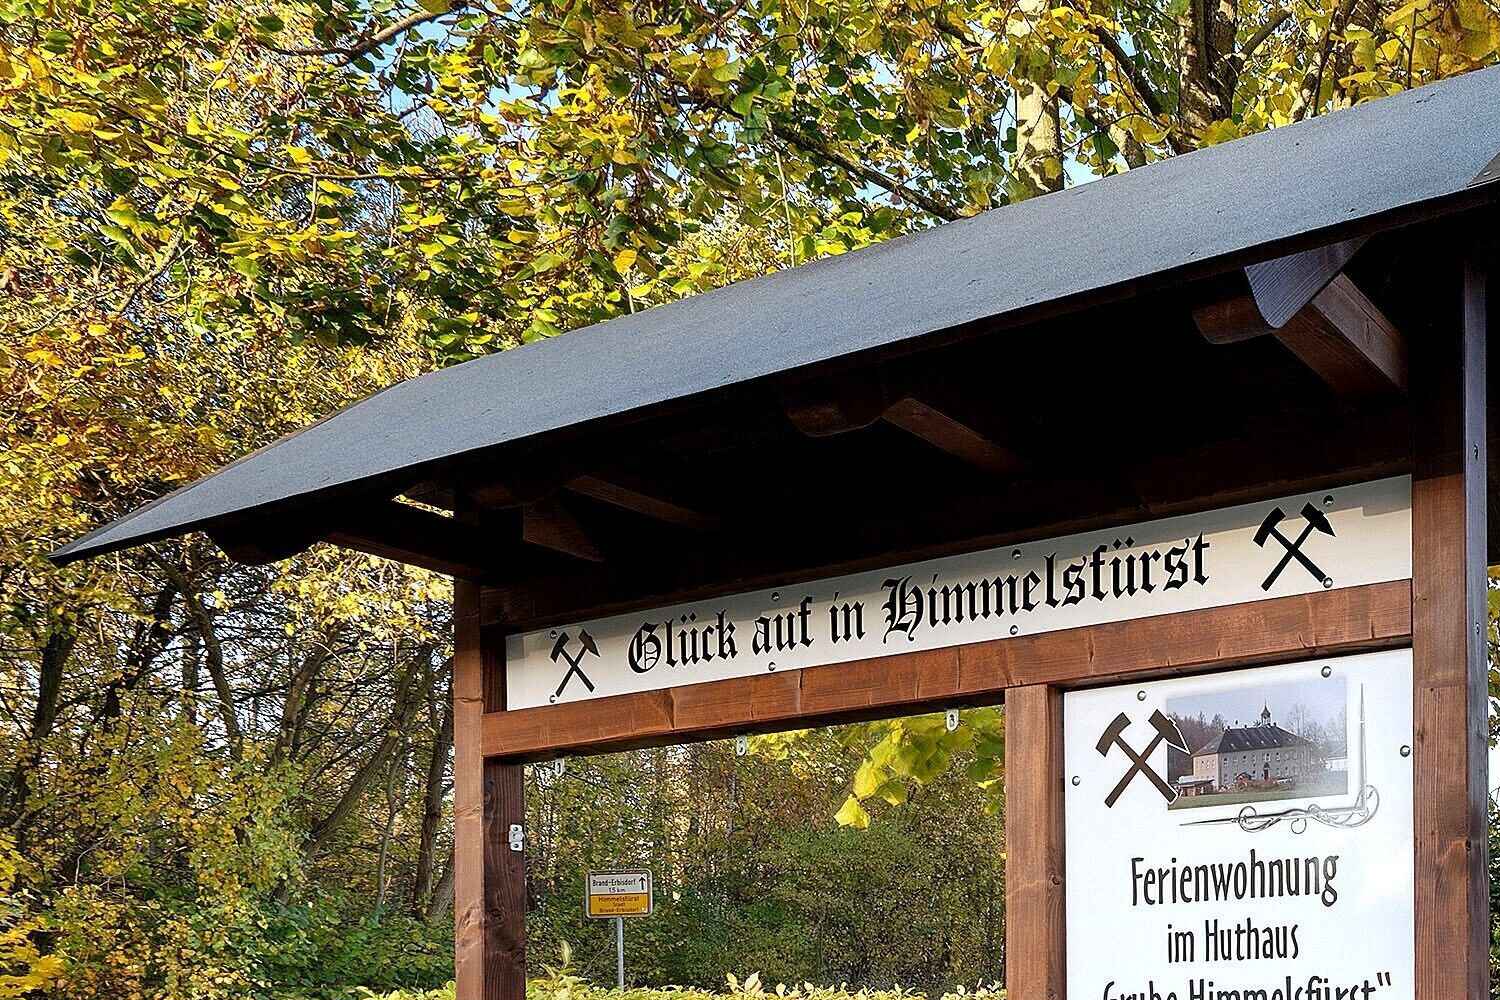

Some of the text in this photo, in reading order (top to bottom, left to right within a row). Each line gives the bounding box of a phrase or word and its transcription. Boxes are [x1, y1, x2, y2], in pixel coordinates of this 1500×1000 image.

[627, 531, 1210, 673] Glück auf in Himmelsfürst
[592, 879, 636, 887] Brand-Erbisdorf
[1131, 848, 1339, 907] Ferienwohnung
[1167, 917, 1299, 963] im Huthaus
